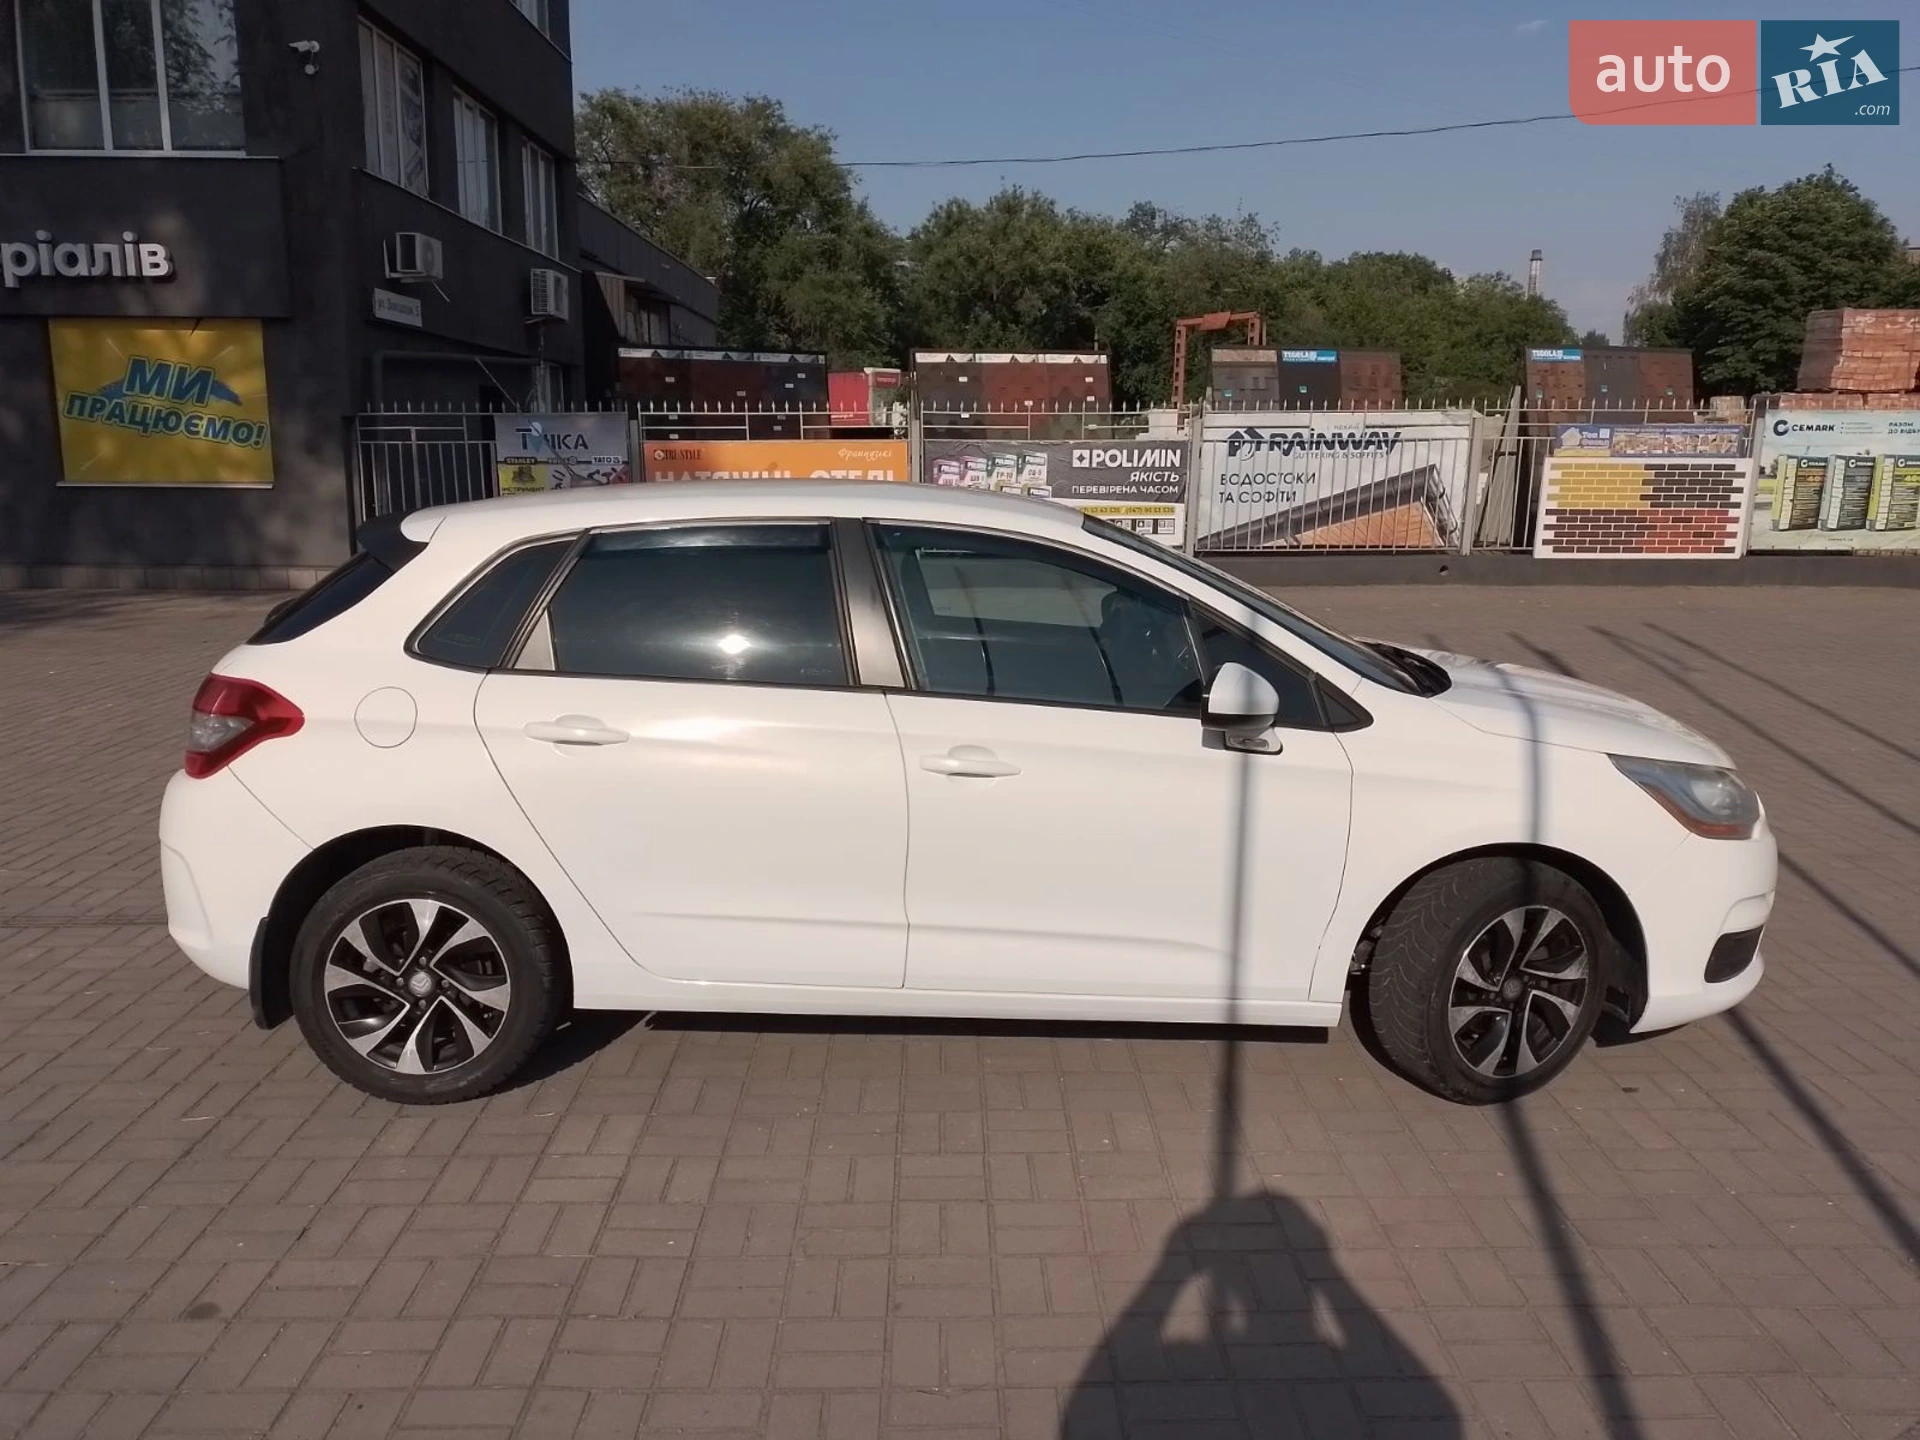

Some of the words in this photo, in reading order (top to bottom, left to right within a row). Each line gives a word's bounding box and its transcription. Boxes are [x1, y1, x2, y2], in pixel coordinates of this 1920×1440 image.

[0, 229, 172, 288] ріалів
[124, 356, 214, 407] МИ
[64, 391, 267, 448] ПРАЦЮЄМО!
[1791, 424, 1836, 432] CEMARK
[1091, 449, 1181, 468] POLIMIN
[1130, 471, 1180, 482] ЯКІСТЬ
[1220, 472, 1316, 486] ВОДОСТОКИ
[1071, 485, 1137, 494] ПЕРЕВІРЕНА
[1140, 485, 1178, 494] ЧАСОМ
[1219, 491, 1237, 504] ТА
[1238, 488, 1297, 504] СОФІТИ
